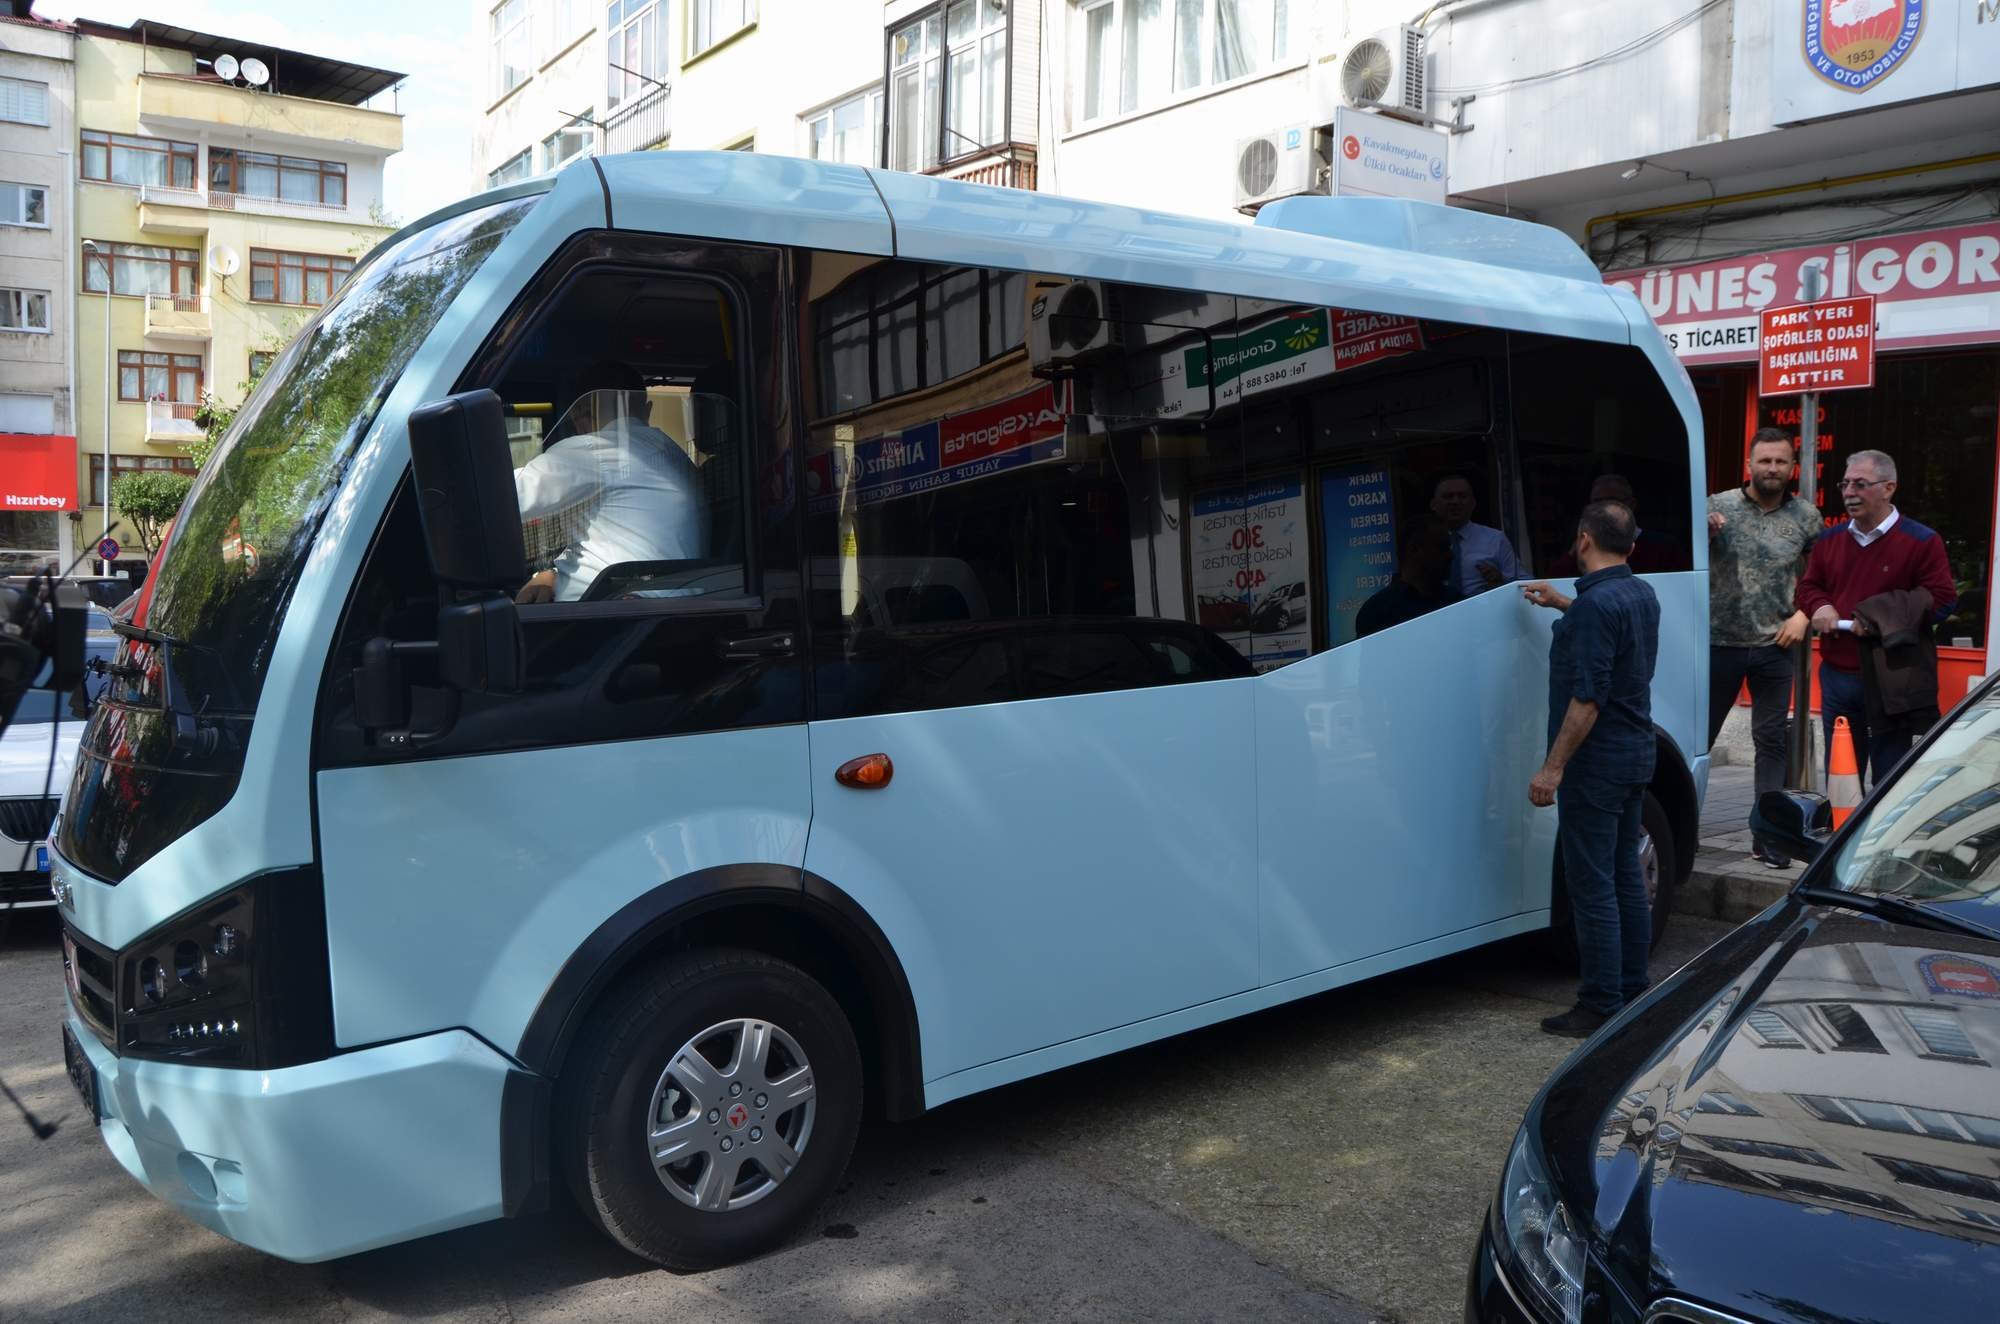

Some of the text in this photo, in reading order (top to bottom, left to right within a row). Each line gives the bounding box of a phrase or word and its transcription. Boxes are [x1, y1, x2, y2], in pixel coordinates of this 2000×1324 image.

[1816, 56, 1832, 72] VE
[1846, 50, 1875, 65] 1953
[1363, 136, 1428, 161] Kavakmeydan
[1364, 154, 1426, 182] Ülkü Ocakları
[1612, 262, 1777, 318] ÜNEŞ
[1772, 311, 1808, 327] PARK
[1686, 327, 1757, 348] TİCARET
[1763, 329, 1823, 351] ŞOFÖRLER
[1827, 324, 1869, 340] ODASI
[1769, 346, 1858, 369] BAŞKANLIĞINA
[6, 495, 66, 508] Hızırbey
